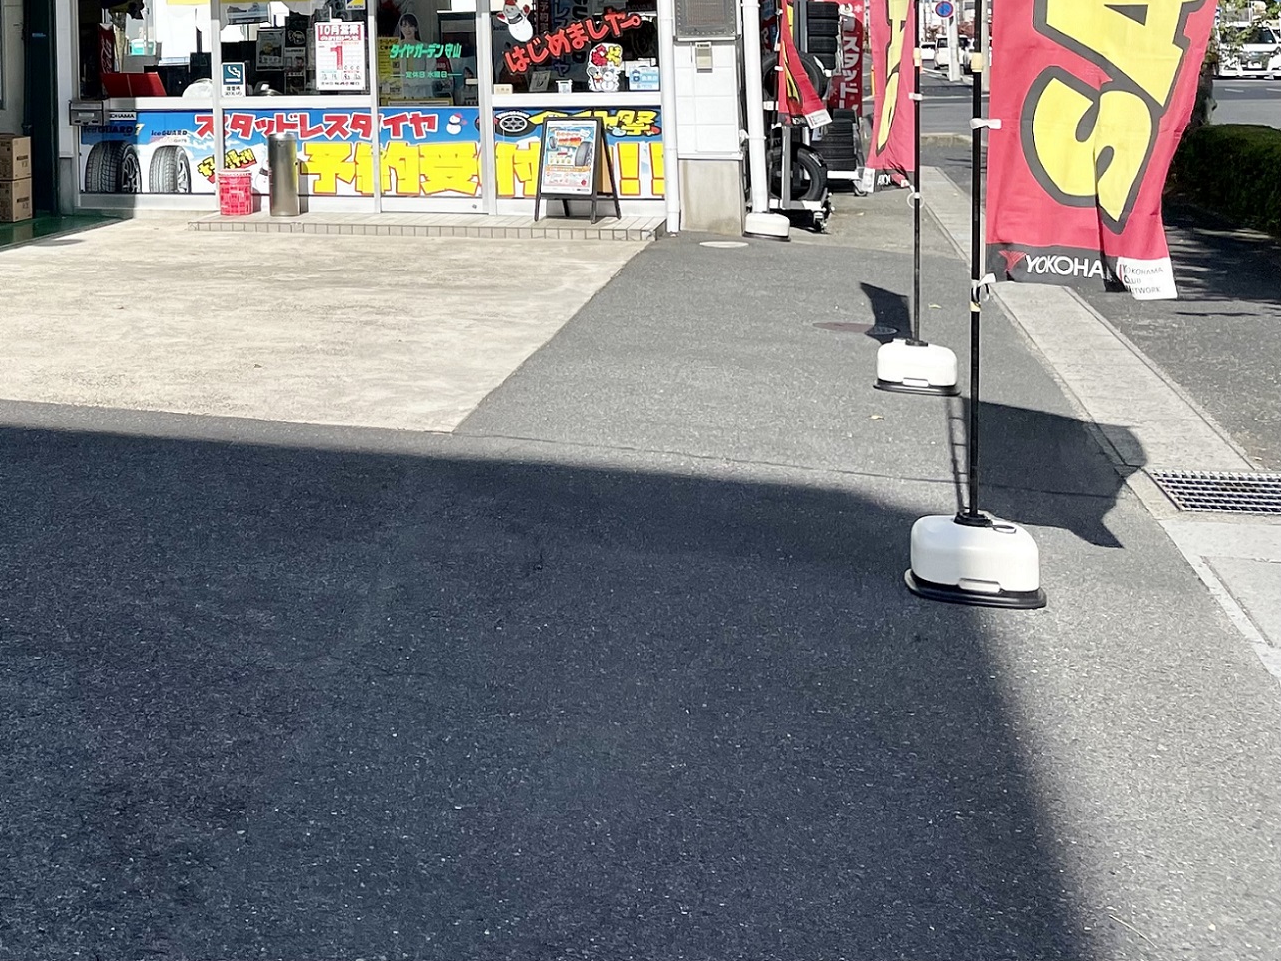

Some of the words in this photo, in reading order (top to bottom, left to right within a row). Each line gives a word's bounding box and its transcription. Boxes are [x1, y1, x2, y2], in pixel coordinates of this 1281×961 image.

[504, 11, 642, 73] はじめました。
[196, 112, 438, 140] スタッドレスタイヤ
[300, 141, 665, 197] 予約受付!!
[1025, 254, 1113, 282] YOKOHA
